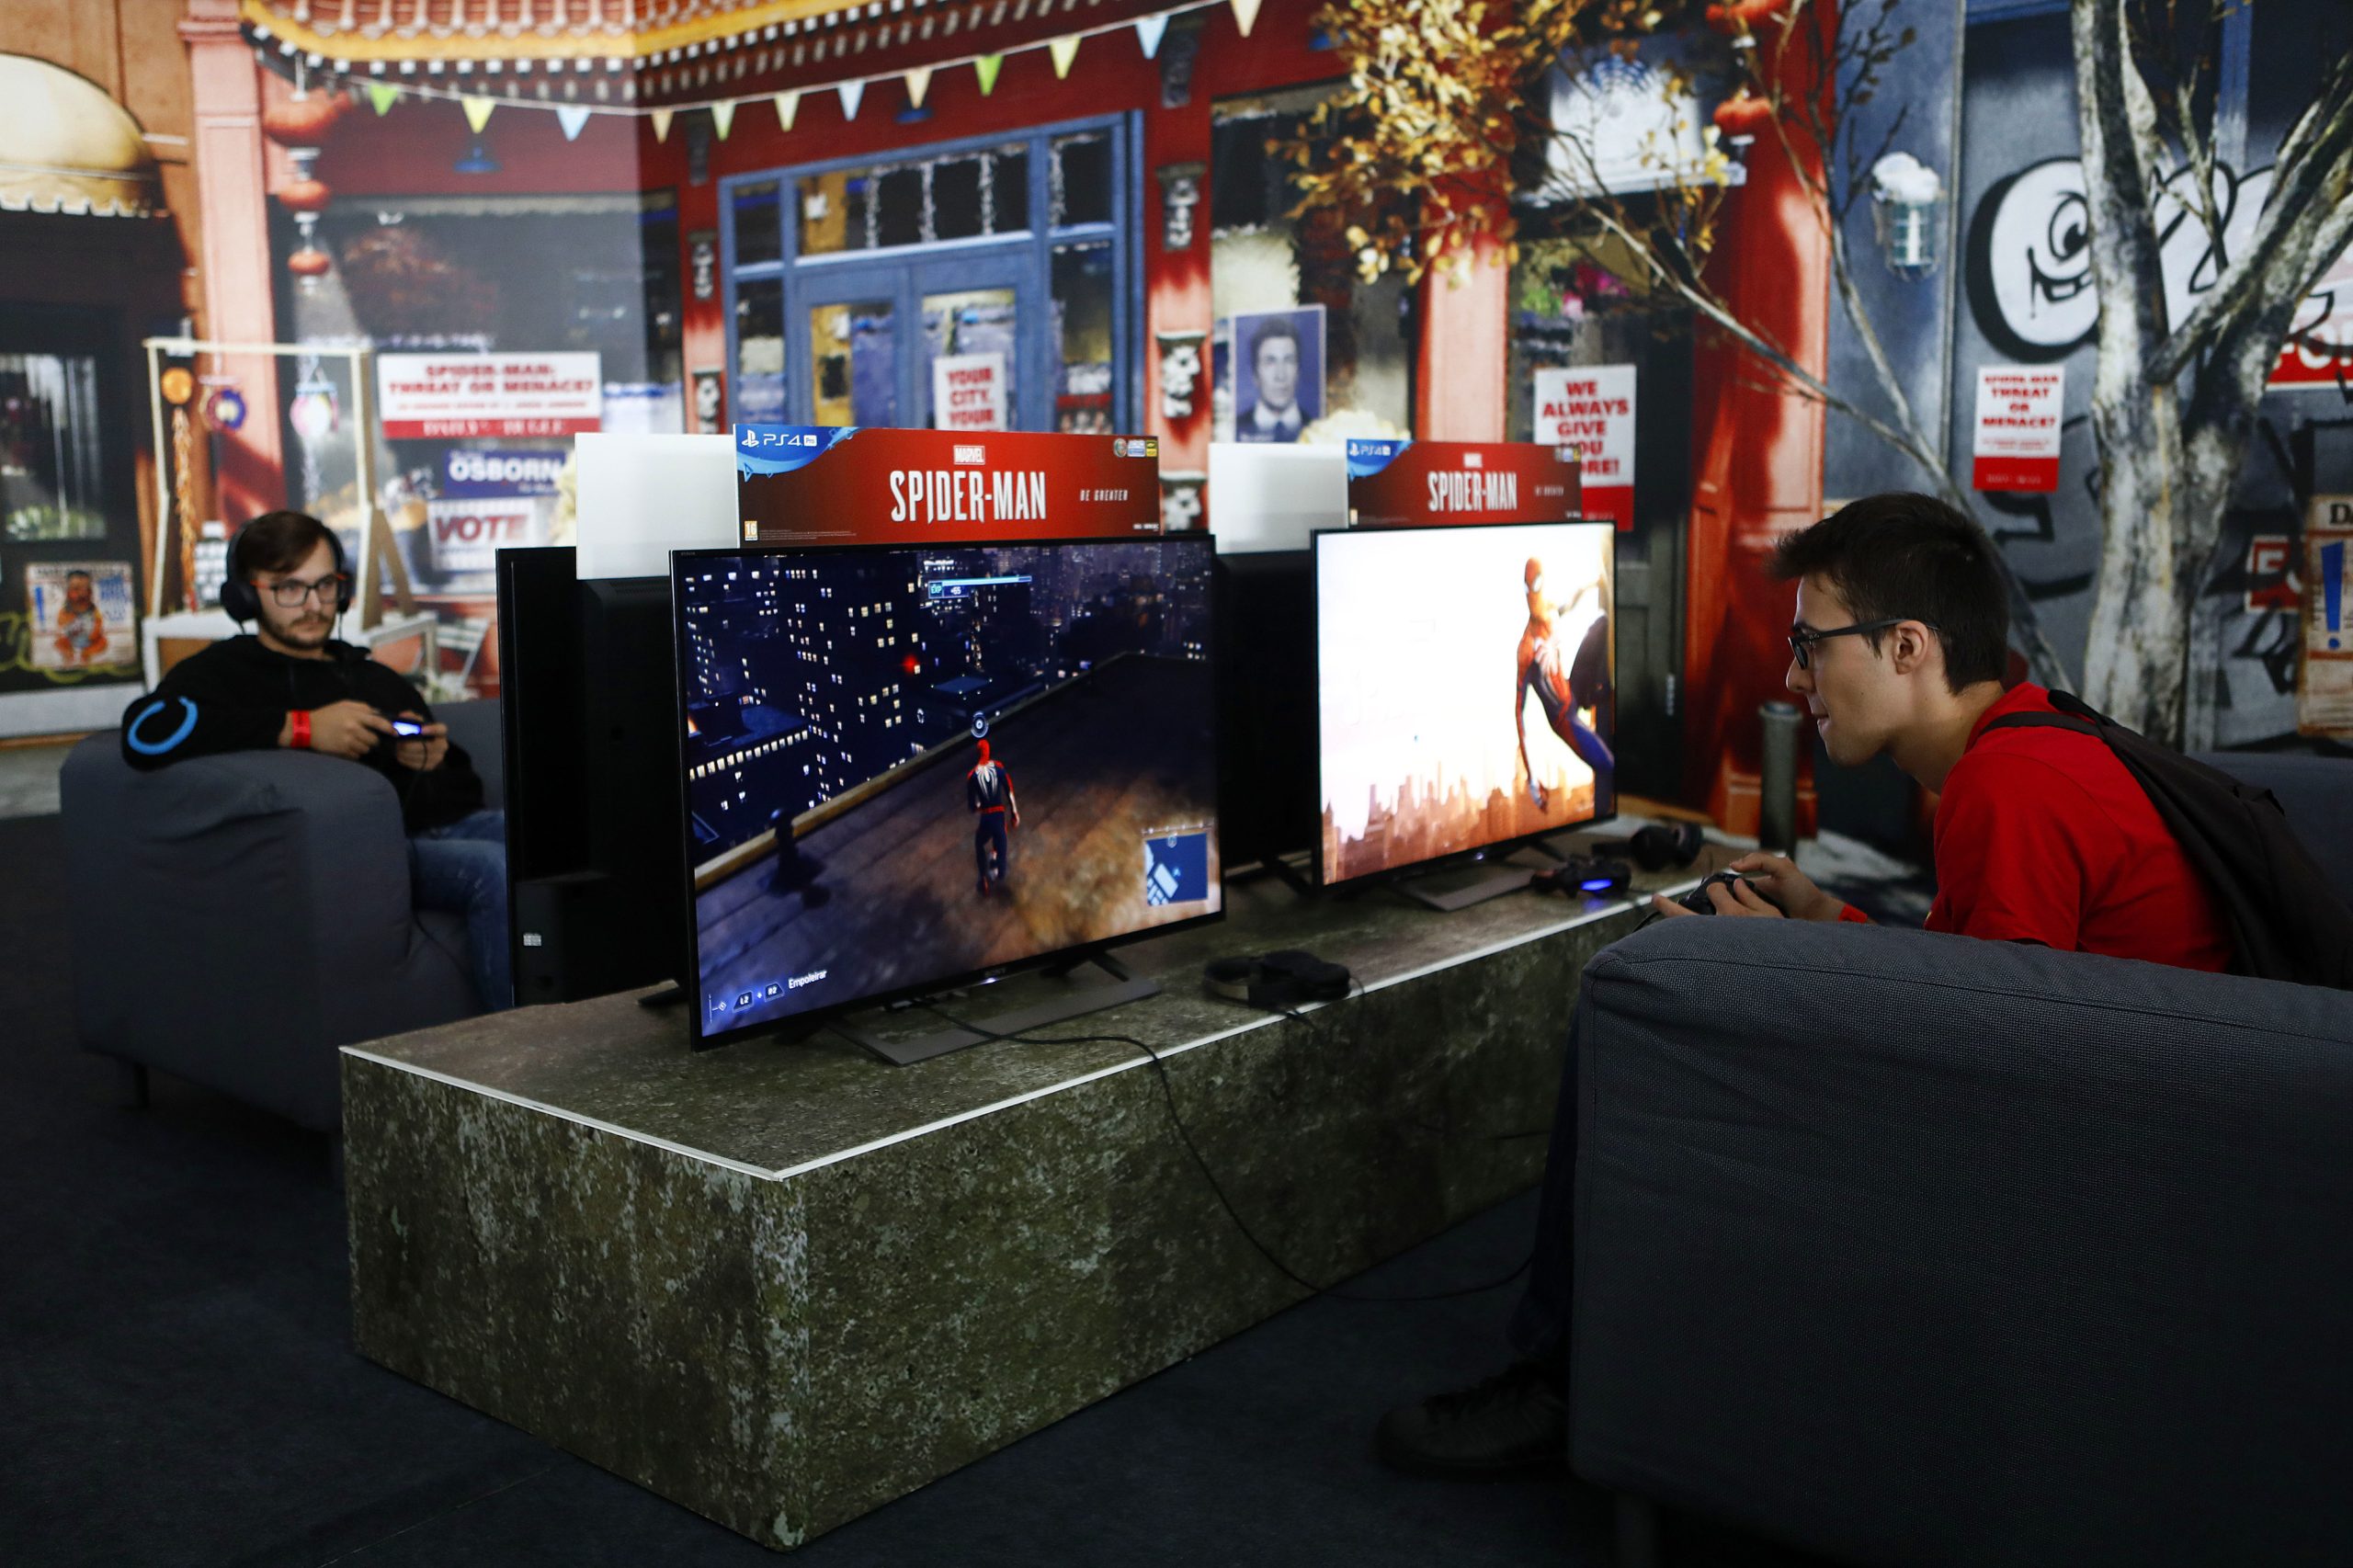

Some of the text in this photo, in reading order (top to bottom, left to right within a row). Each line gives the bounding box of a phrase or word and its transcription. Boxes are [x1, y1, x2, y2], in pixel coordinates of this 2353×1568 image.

[948, 368, 992, 385] YOUR
[389, 381, 460, 393] THREAT
[469, 381, 494, 392] OR
[1566, 381, 1597, 396] WE
[1543, 398, 1629, 418] ALWAYS
[1557, 420, 1607, 437] GIVE
[763, 434, 801, 447] PS4
[954, 447, 985, 464] MARVEL
[890, 471, 1046, 524] SPIDER-MAN
[1427, 471, 1517, 513] SPIDER-MAN
[435, 514, 529, 542] VOTE
[745, 522, 756, 536] 16
[789, 971, 827, 989] Empoleirar
